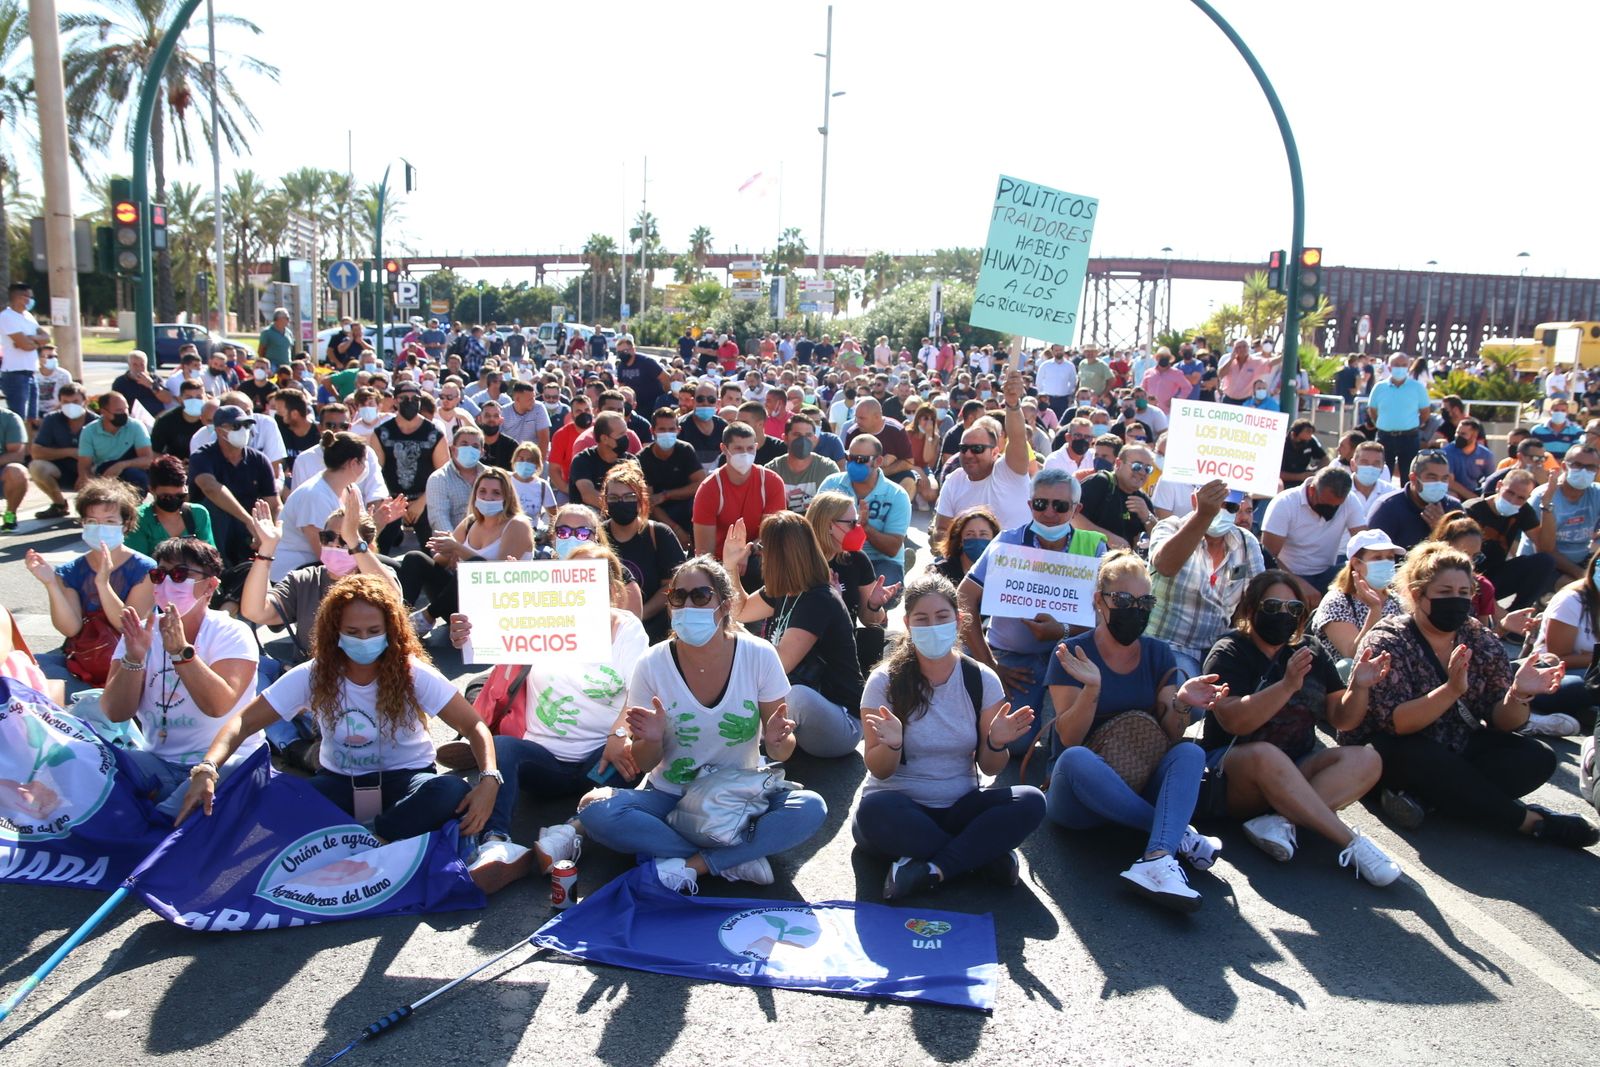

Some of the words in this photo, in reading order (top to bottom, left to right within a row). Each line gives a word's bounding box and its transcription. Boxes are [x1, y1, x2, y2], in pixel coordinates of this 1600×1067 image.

[994, 205, 1092, 243] TRAIDORES
[1016, 235, 1070, 260] HABEIS
[1004, 279, 1018, 293] A
[1023, 284, 1057, 300] LOS
[1181, 407, 1191, 417] SI
[1194, 408, 1205, 418] EL
[1208, 410, 1244, 423] CAMPO
[1245, 414, 1279, 430] MUERE
[1195, 424, 1217, 439] LOS
[1219, 427, 1268, 447] PUEBLOS
[1197, 459, 1255, 481] VACIOS
[471, 571, 482, 584] SI
[486, 571, 500, 584] EL
[504, 570, 549, 584] CAMPO
[551, 568, 597, 583] MUERE
[994, 554, 1009, 567] NO
[1010, 558, 1018, 569] A
[1018, 559, 1031, 570] LA
[1032, 560, 1095, 581] IMPORTACIÓN
[492, 591, 520, 609] LOS
[523, 590, 586, 608] PUEBLOS
[1006, 579, 1025, 592] POR
[1026, 582, 1061, 597] DEBAJO
[1062, 588, 1079, 600] DEL
[1000, 593, 1033, 607] PRECIO
[1035, 600, 1047, 609] DE
[1049, 601, 1079, 613] COSTE
[499, 615, 576, 631] QUEDARAN
[501, 634, 578, 652] VACIOS
[281, 845, 322, 873] Unión
[323, 834, 338, 850] de
[268, 884, 338, 906] Agricultoras
[342, 889, 362, 906] del
[362, 878, 391, 900] llano
[912, 939, 942, 949] UAI
